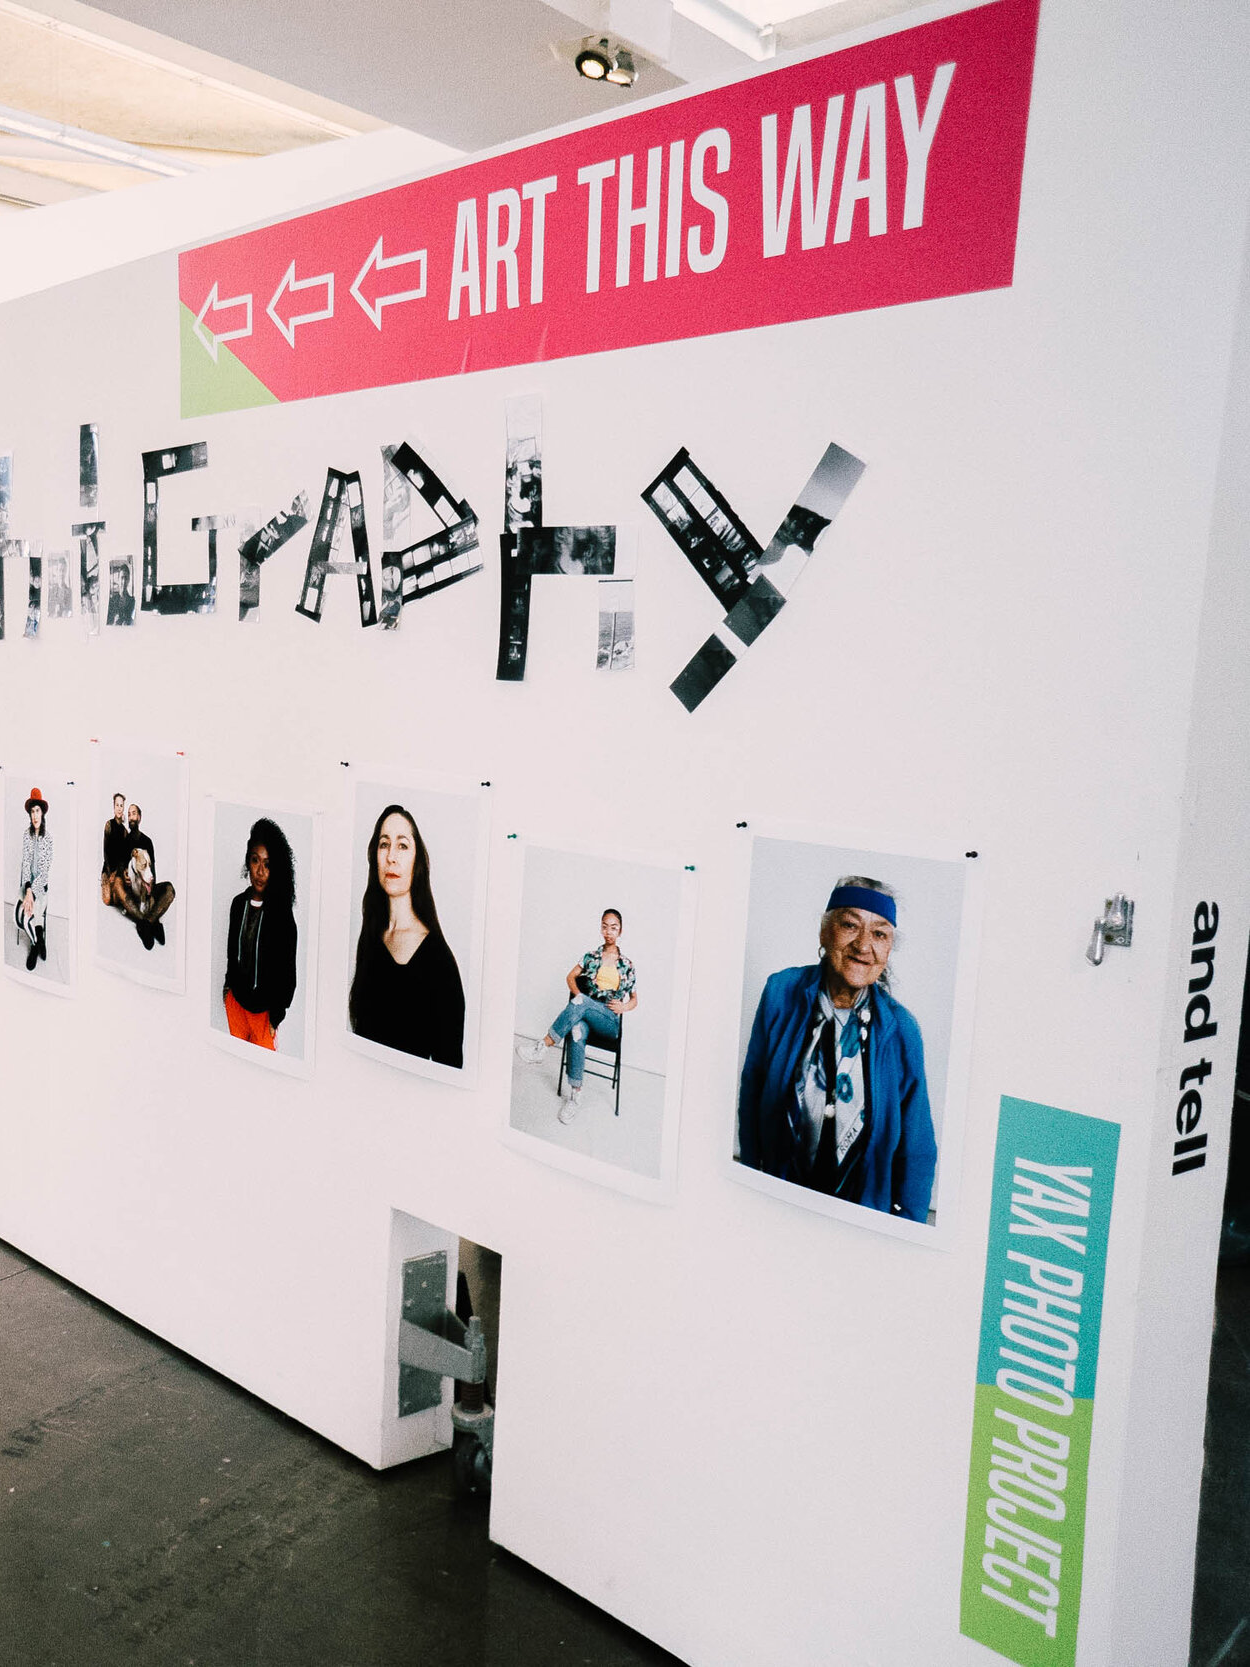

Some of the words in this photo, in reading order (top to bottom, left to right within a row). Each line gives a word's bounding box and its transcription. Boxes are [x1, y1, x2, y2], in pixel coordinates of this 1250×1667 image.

[447, 174, 557, 321] ART
[577, 127, 731, 294] THIS
[759, 62, 956, 259] WAY
[1183, 900, 1220, 1043] and
[1171, 1057, 1213, 1177] tell
[1008, 1155, 1094, 1257] YAX
[995, 1249, 1085, 1417] PHOTO
[980, 1407, 1071, 1639] PROJECT
